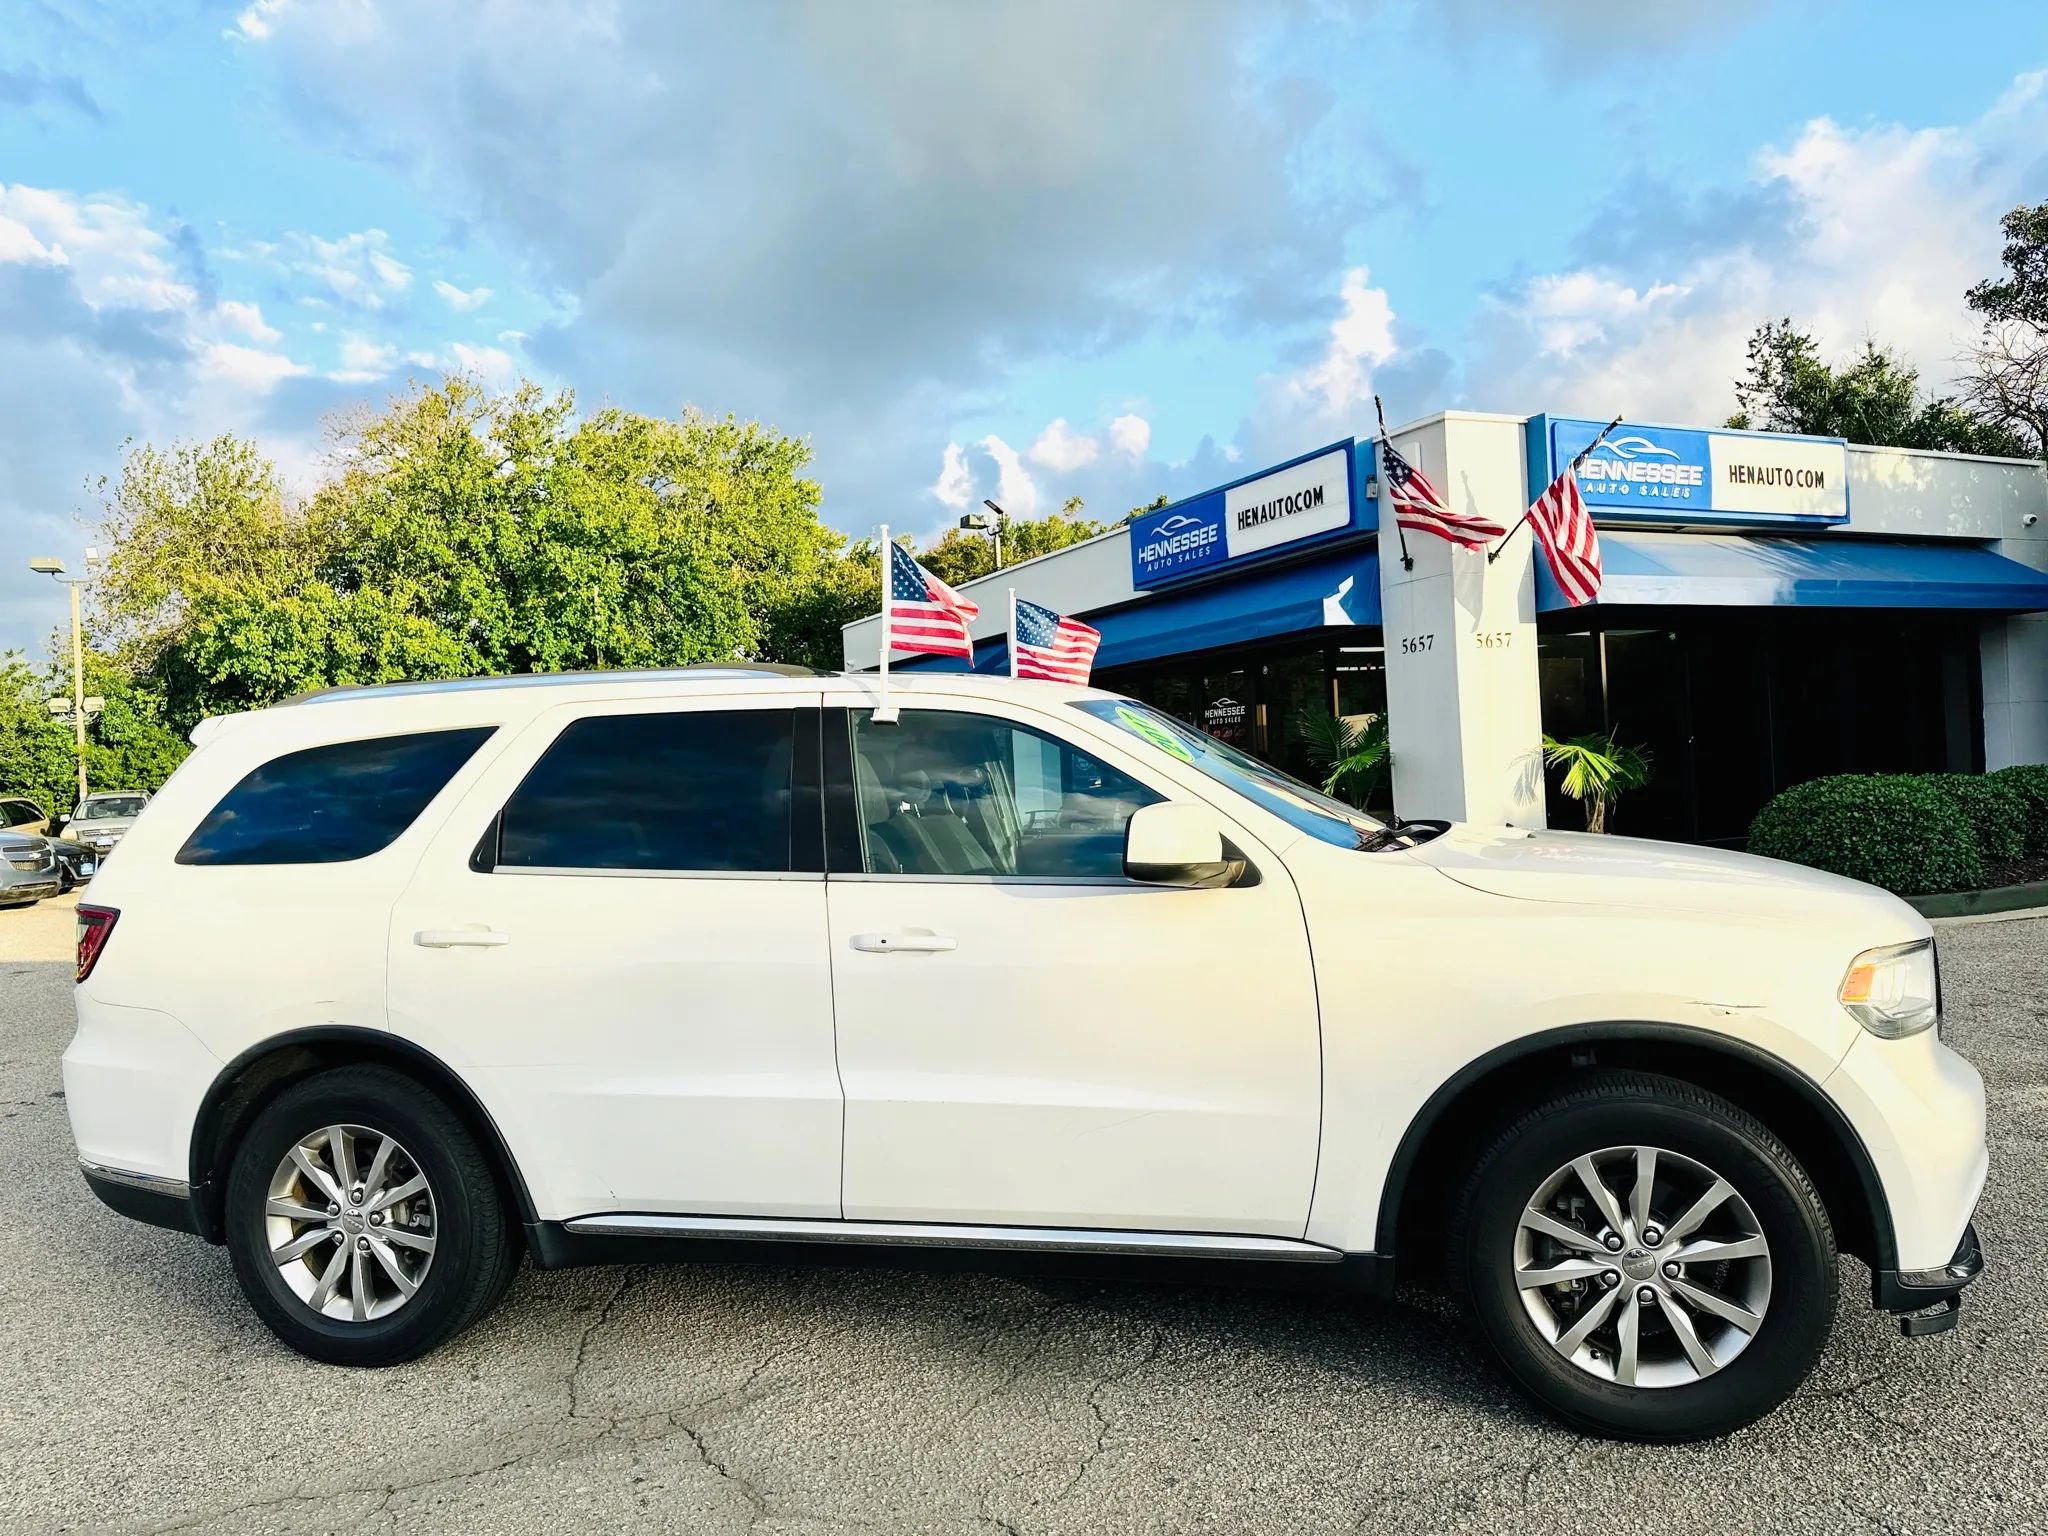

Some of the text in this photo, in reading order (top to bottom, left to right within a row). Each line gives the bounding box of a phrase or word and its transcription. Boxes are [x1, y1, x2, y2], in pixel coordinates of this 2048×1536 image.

[1585, 483, 1691, 499] AUTO SALES
[1238, 485, 1324, 530] HENAUTO.COM
[1139, 523, 1218, 564] HENNESSEE
[1147, 546, 1211, 572] AUTO SALES
[1402, 634, 1434, 654] 5657
[1476, 632, 1512, 648] 5657
[1205, 706, 1246, 718] HENNESSEE
[1225, 716, 1241, 724] SALES
